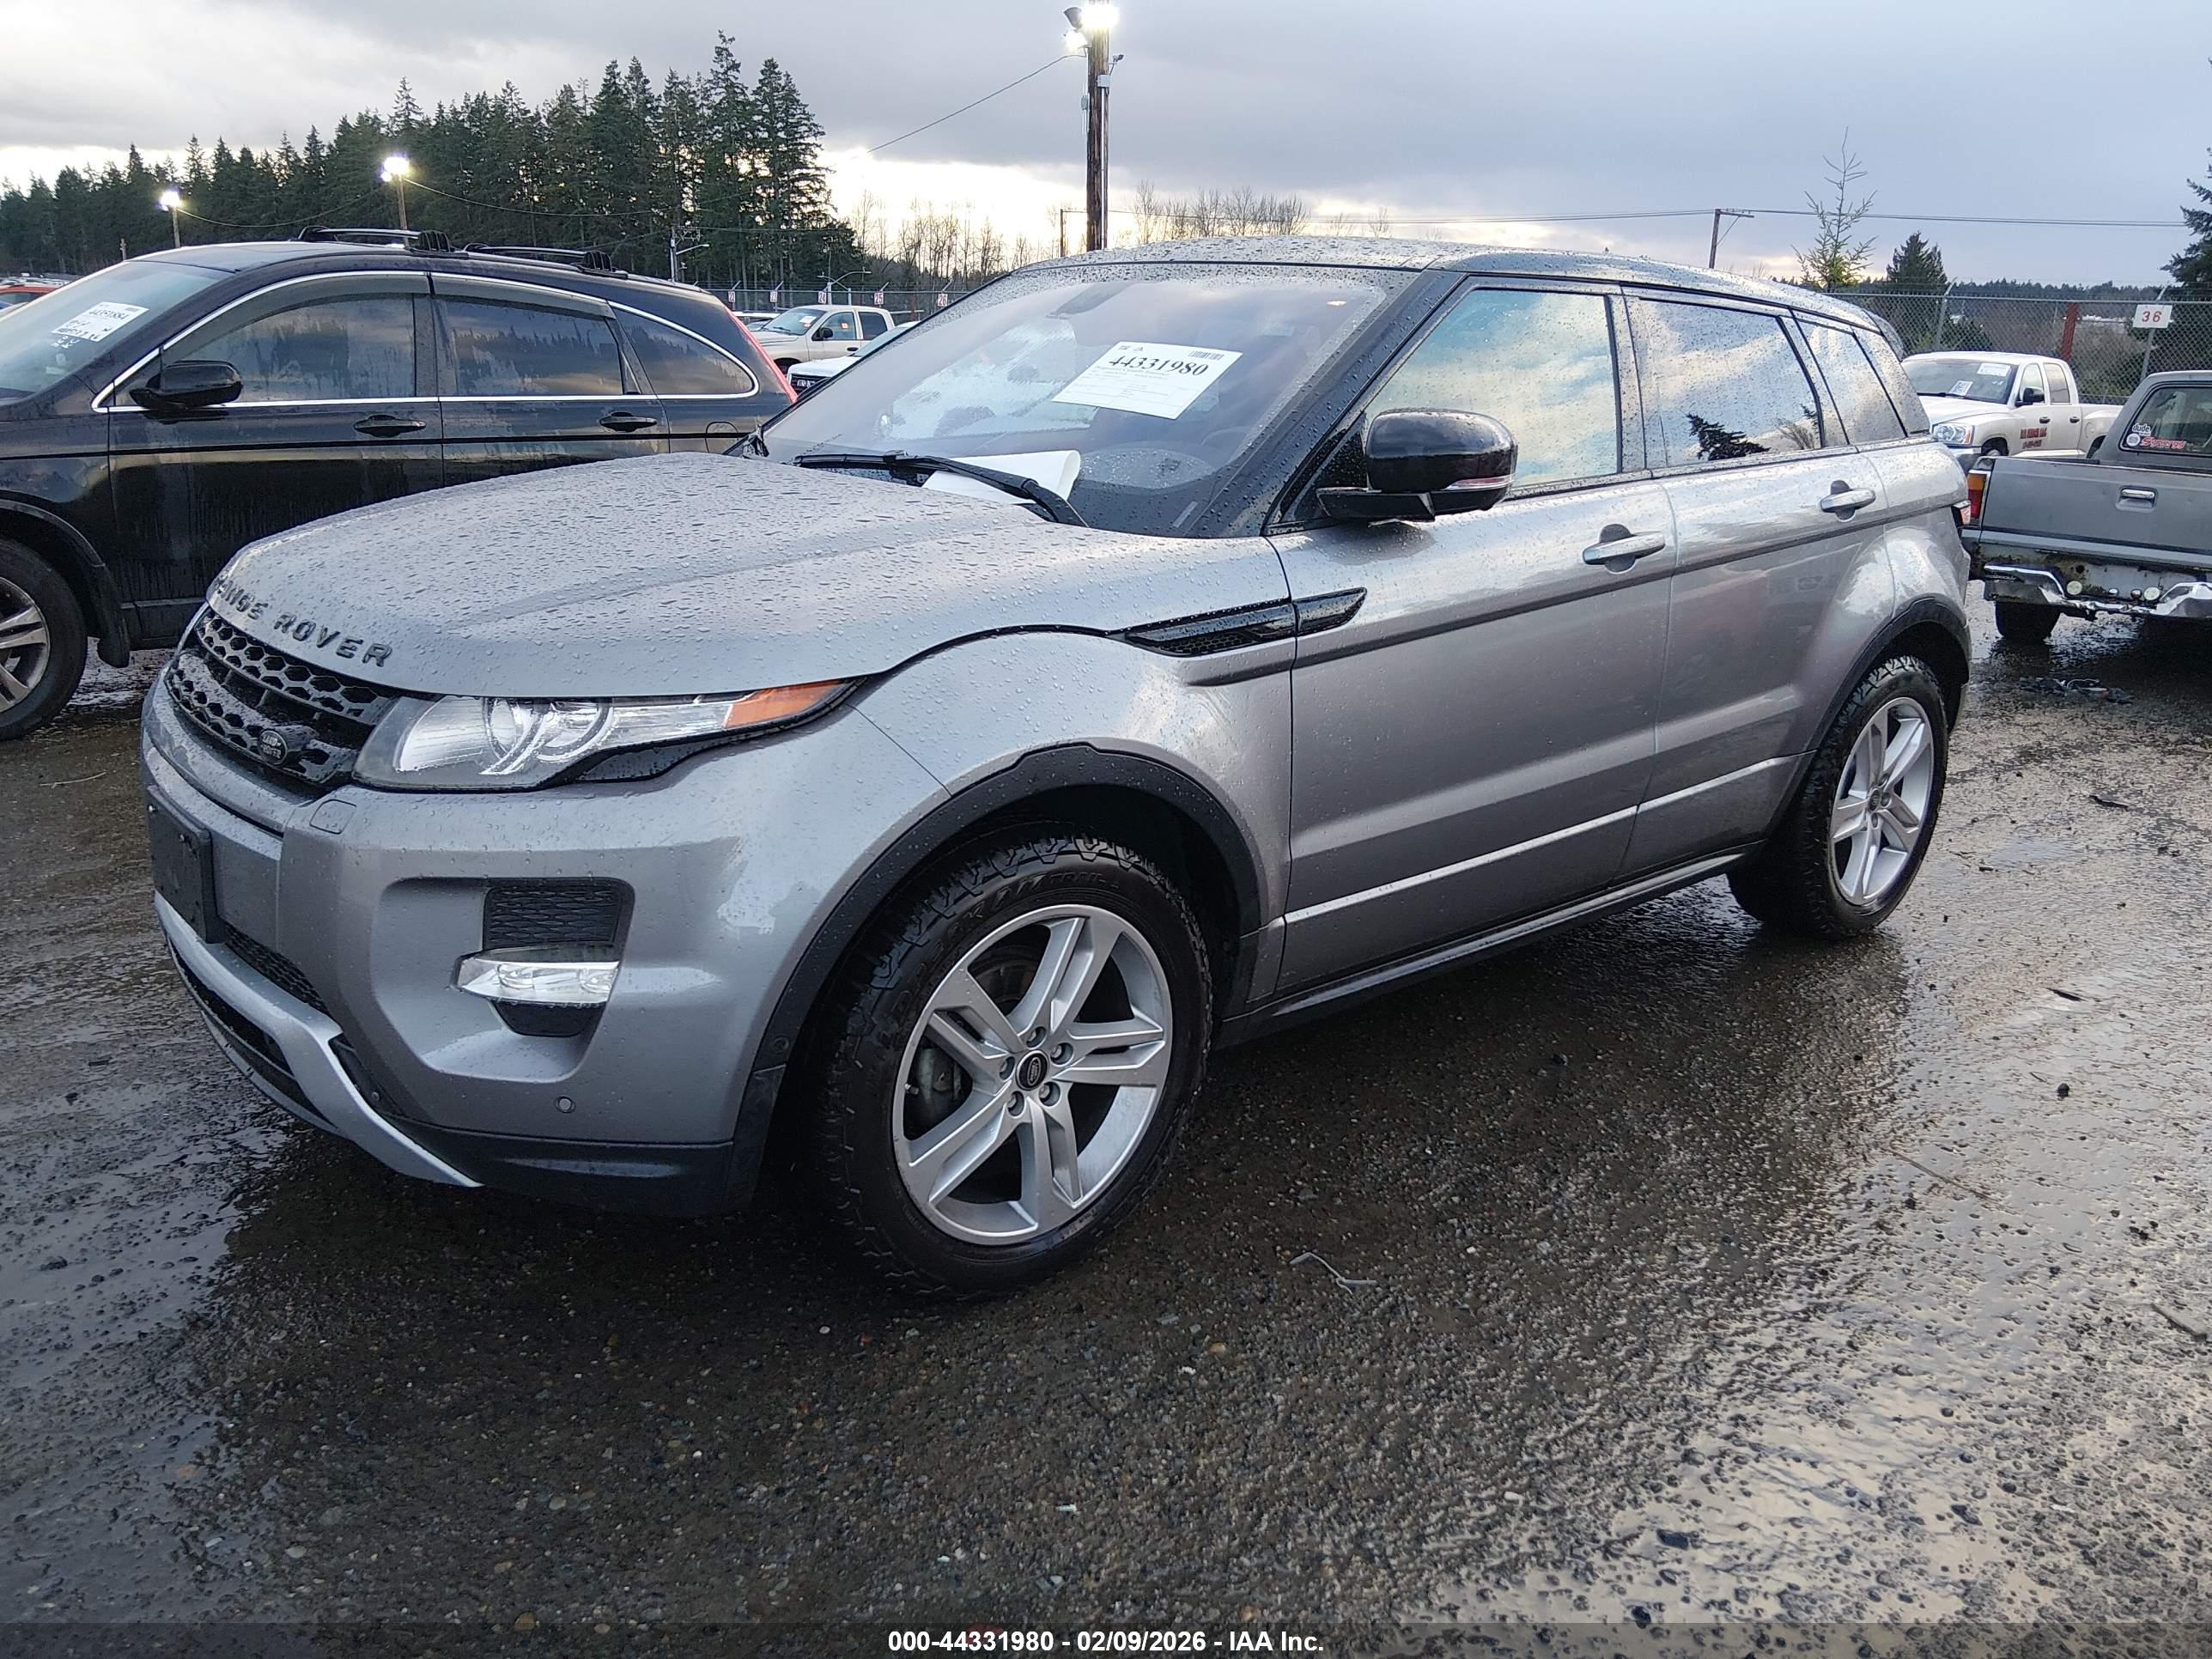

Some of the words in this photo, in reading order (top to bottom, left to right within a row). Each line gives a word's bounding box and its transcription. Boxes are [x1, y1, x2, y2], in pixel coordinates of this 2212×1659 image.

[875, 294, 883, 304] 25
[939, 295, 946, 306] 26
[2142, 310, 2162, 323] 36
[1109, 356, 1209, 376] 44331980
[273, 613, 392, 667] ROVER
